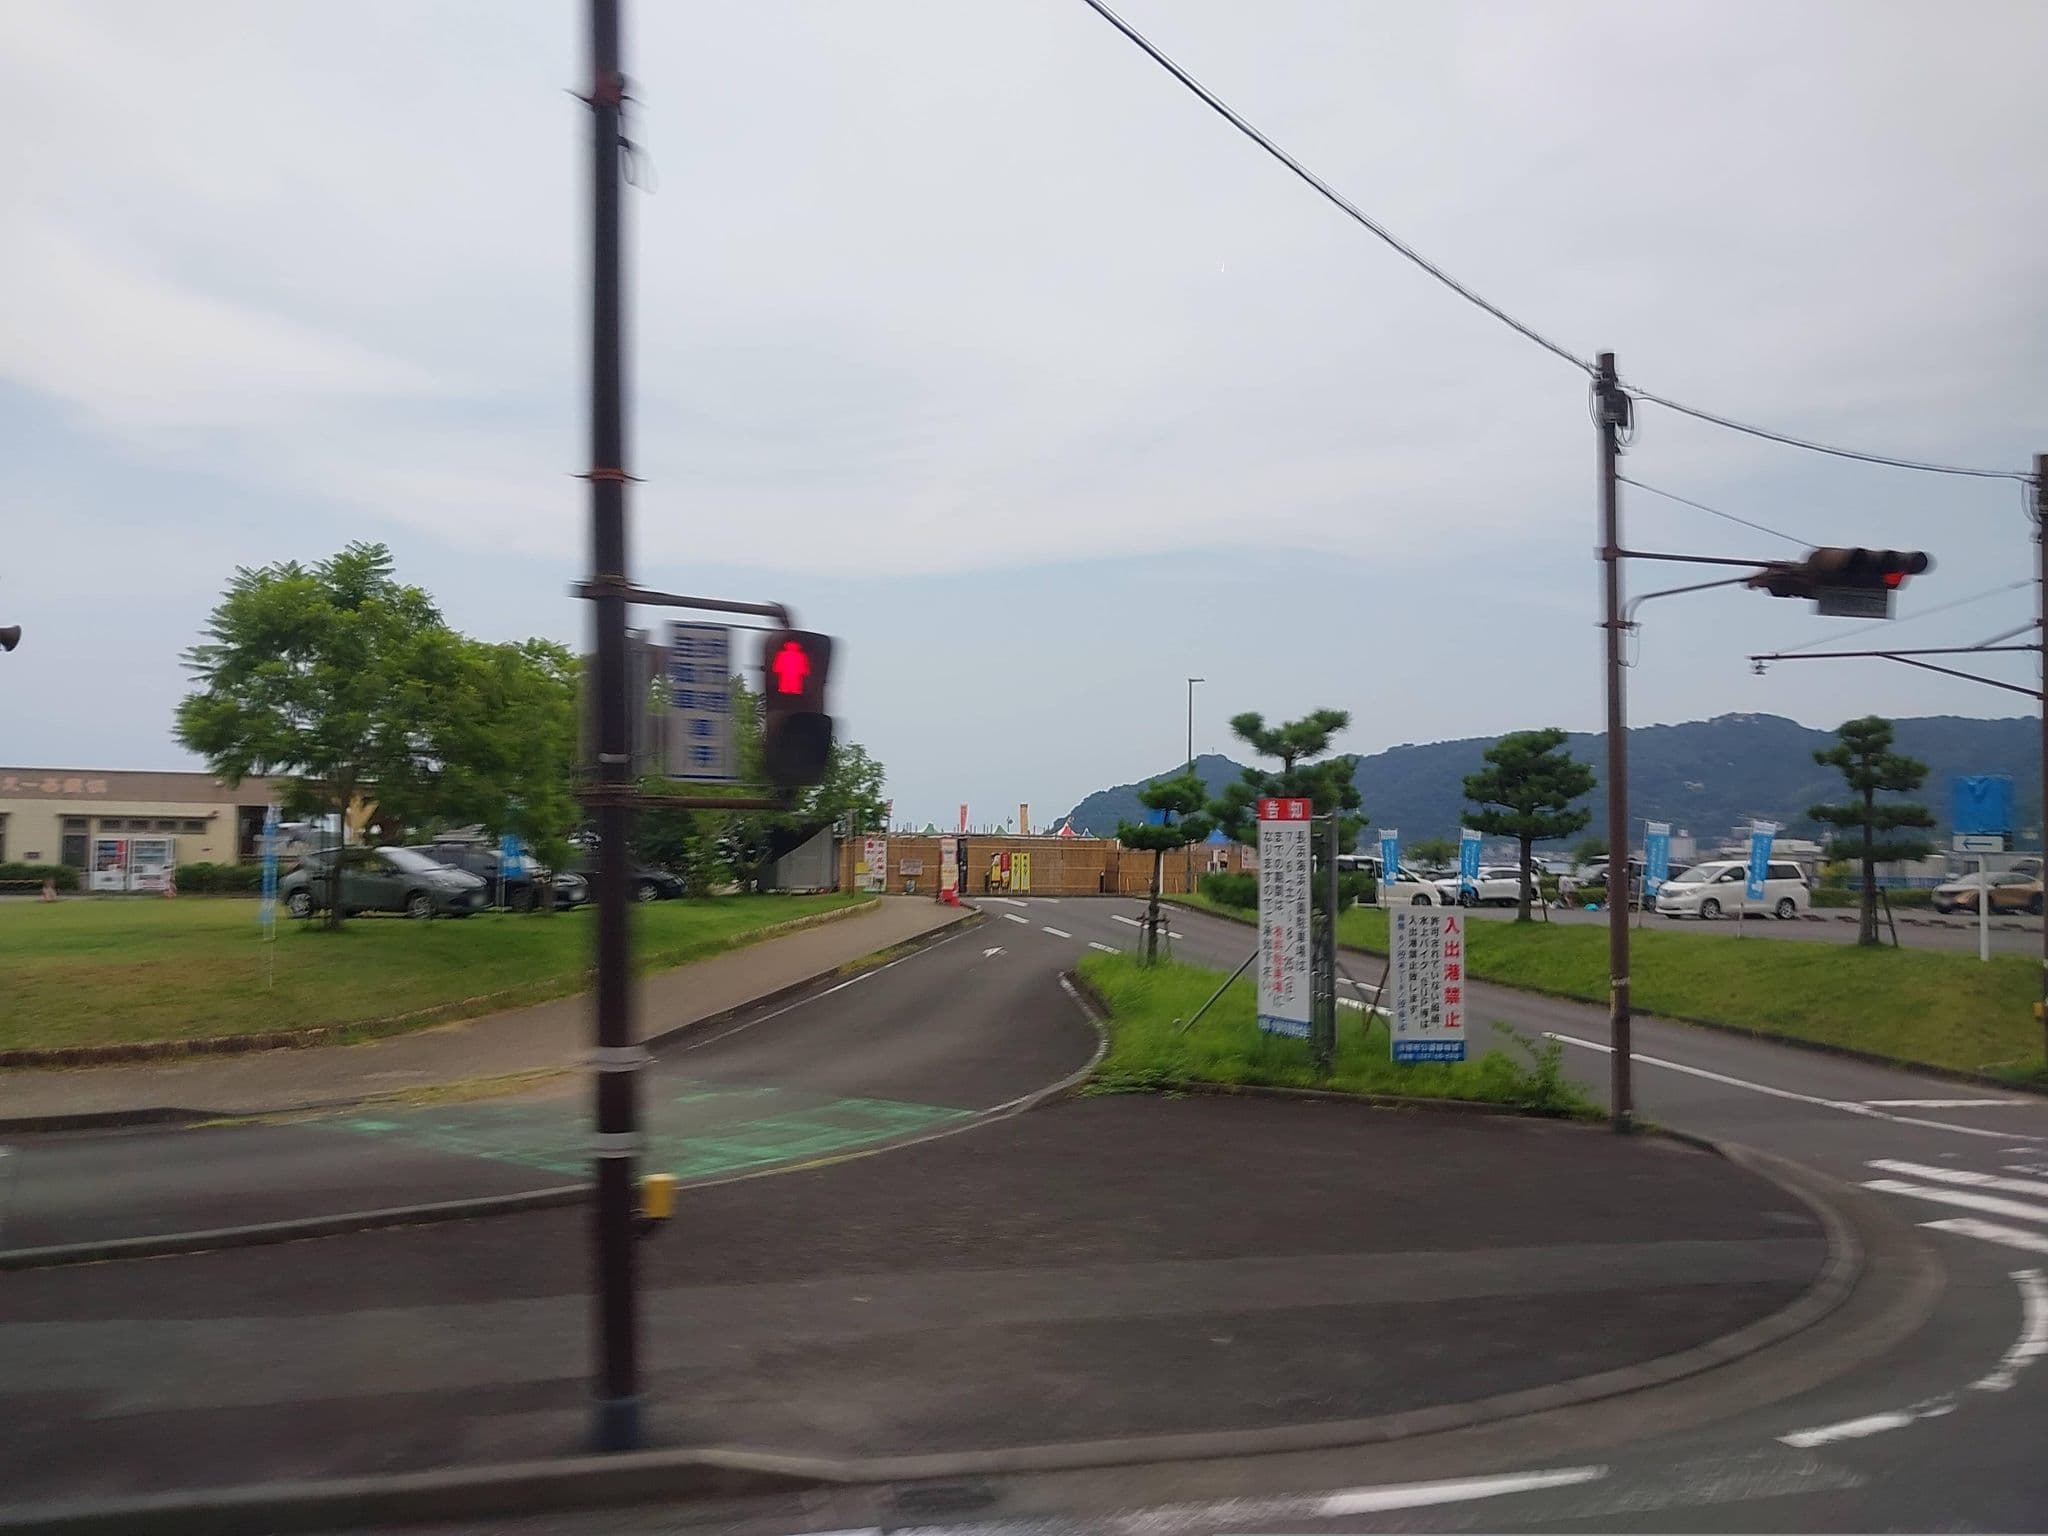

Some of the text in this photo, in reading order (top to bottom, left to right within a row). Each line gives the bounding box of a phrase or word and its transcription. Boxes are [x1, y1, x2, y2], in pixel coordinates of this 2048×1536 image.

[1266, 800, 1303, 819] 告知
[1444, 916, 1460, 1028] 入出港禁止
